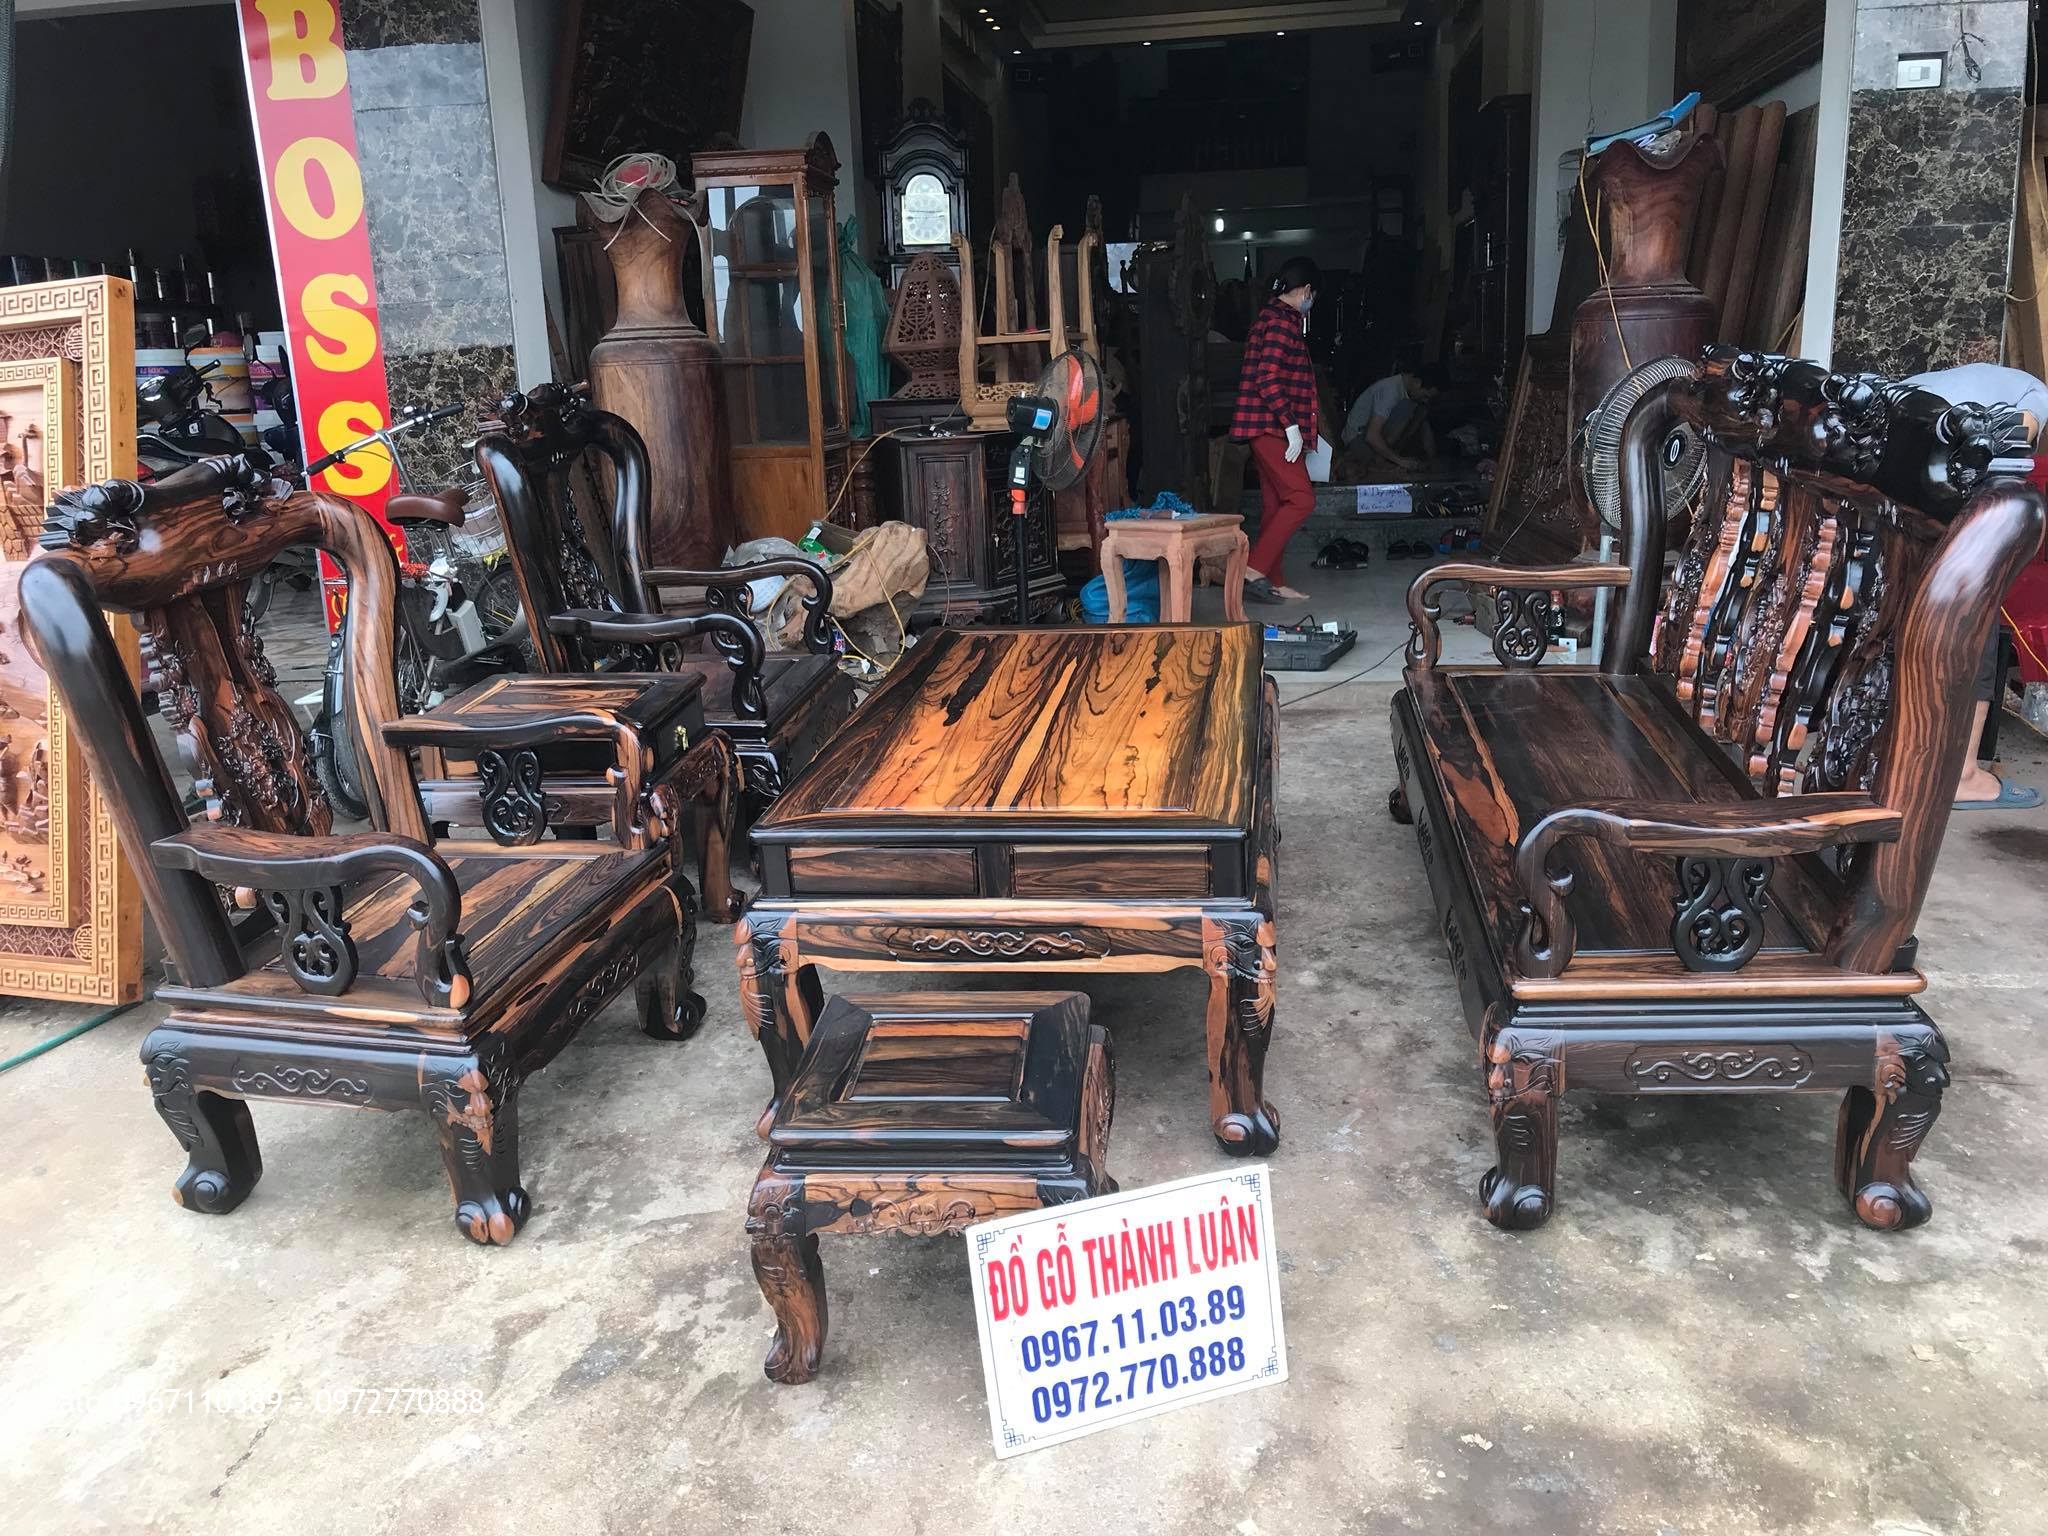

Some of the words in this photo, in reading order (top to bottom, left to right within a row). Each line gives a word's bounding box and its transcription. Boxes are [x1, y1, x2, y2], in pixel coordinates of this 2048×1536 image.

[255, 0, 393, 497] BOSS
[987, 1234, 1029, 1322] ĐỒ
[1036, 1223, 1077, 1311] GỖ
[1081, 1218, 1178, 1299] THÀNH
[1183, 1195, 1260, 1274] LUÂN
[1020, 1284, 1246, 1373] 0967.11.03.89
[1031, 1336, 1246, 1424] 0972.770.888
